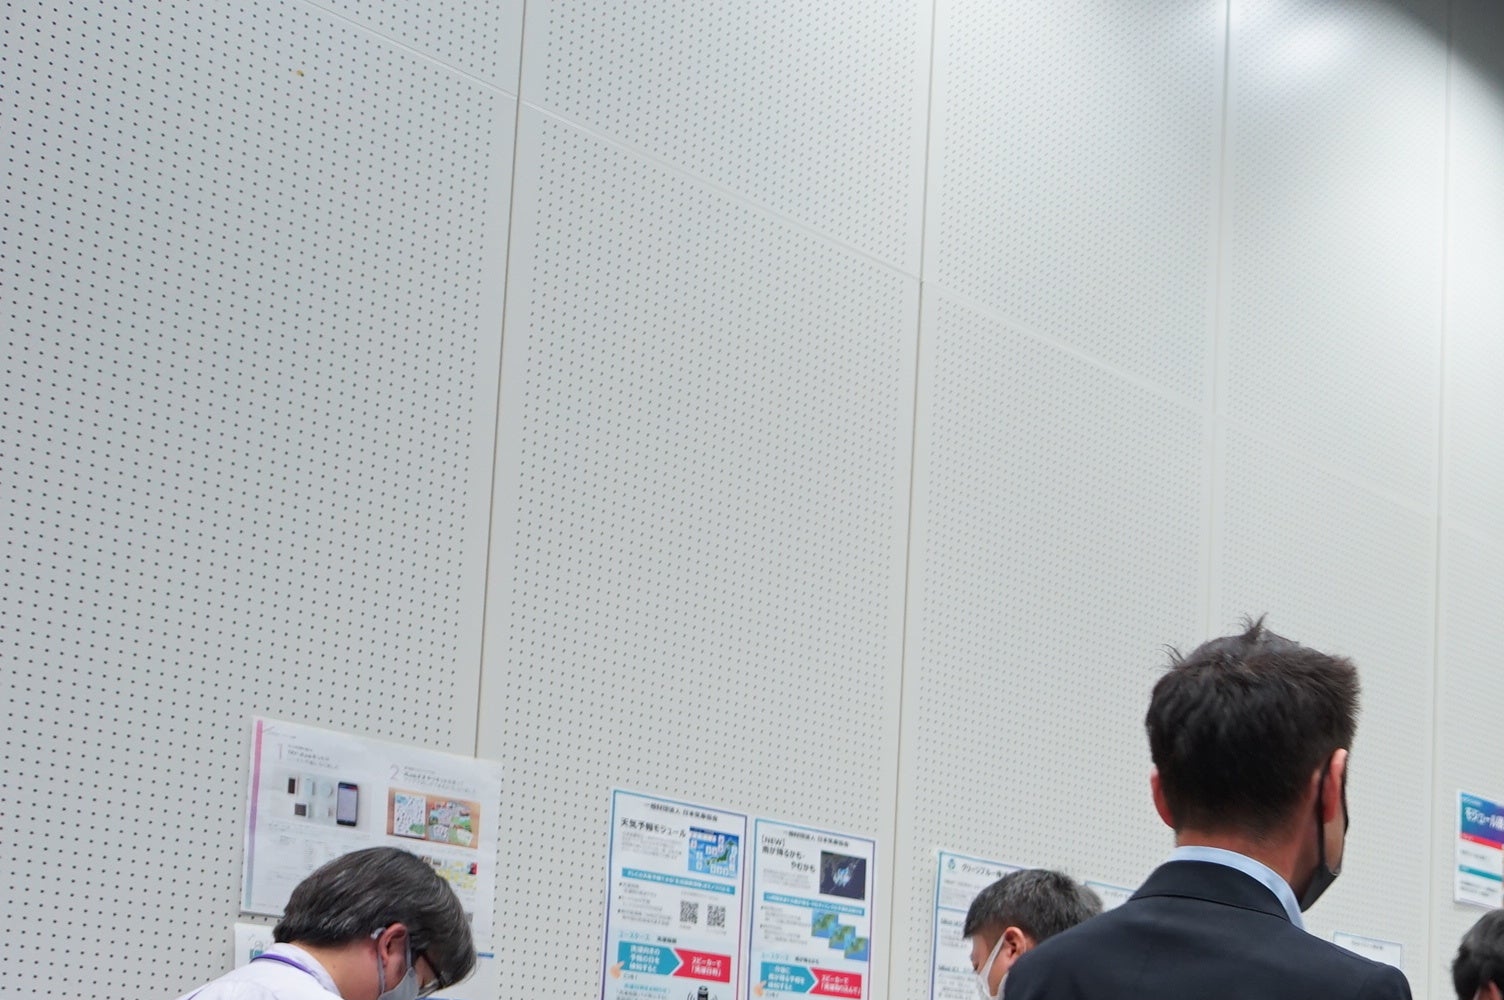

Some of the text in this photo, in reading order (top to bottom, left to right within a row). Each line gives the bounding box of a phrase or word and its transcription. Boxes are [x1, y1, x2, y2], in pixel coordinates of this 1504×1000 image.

[620, 817, 686, 838] 天気予報モジュール
